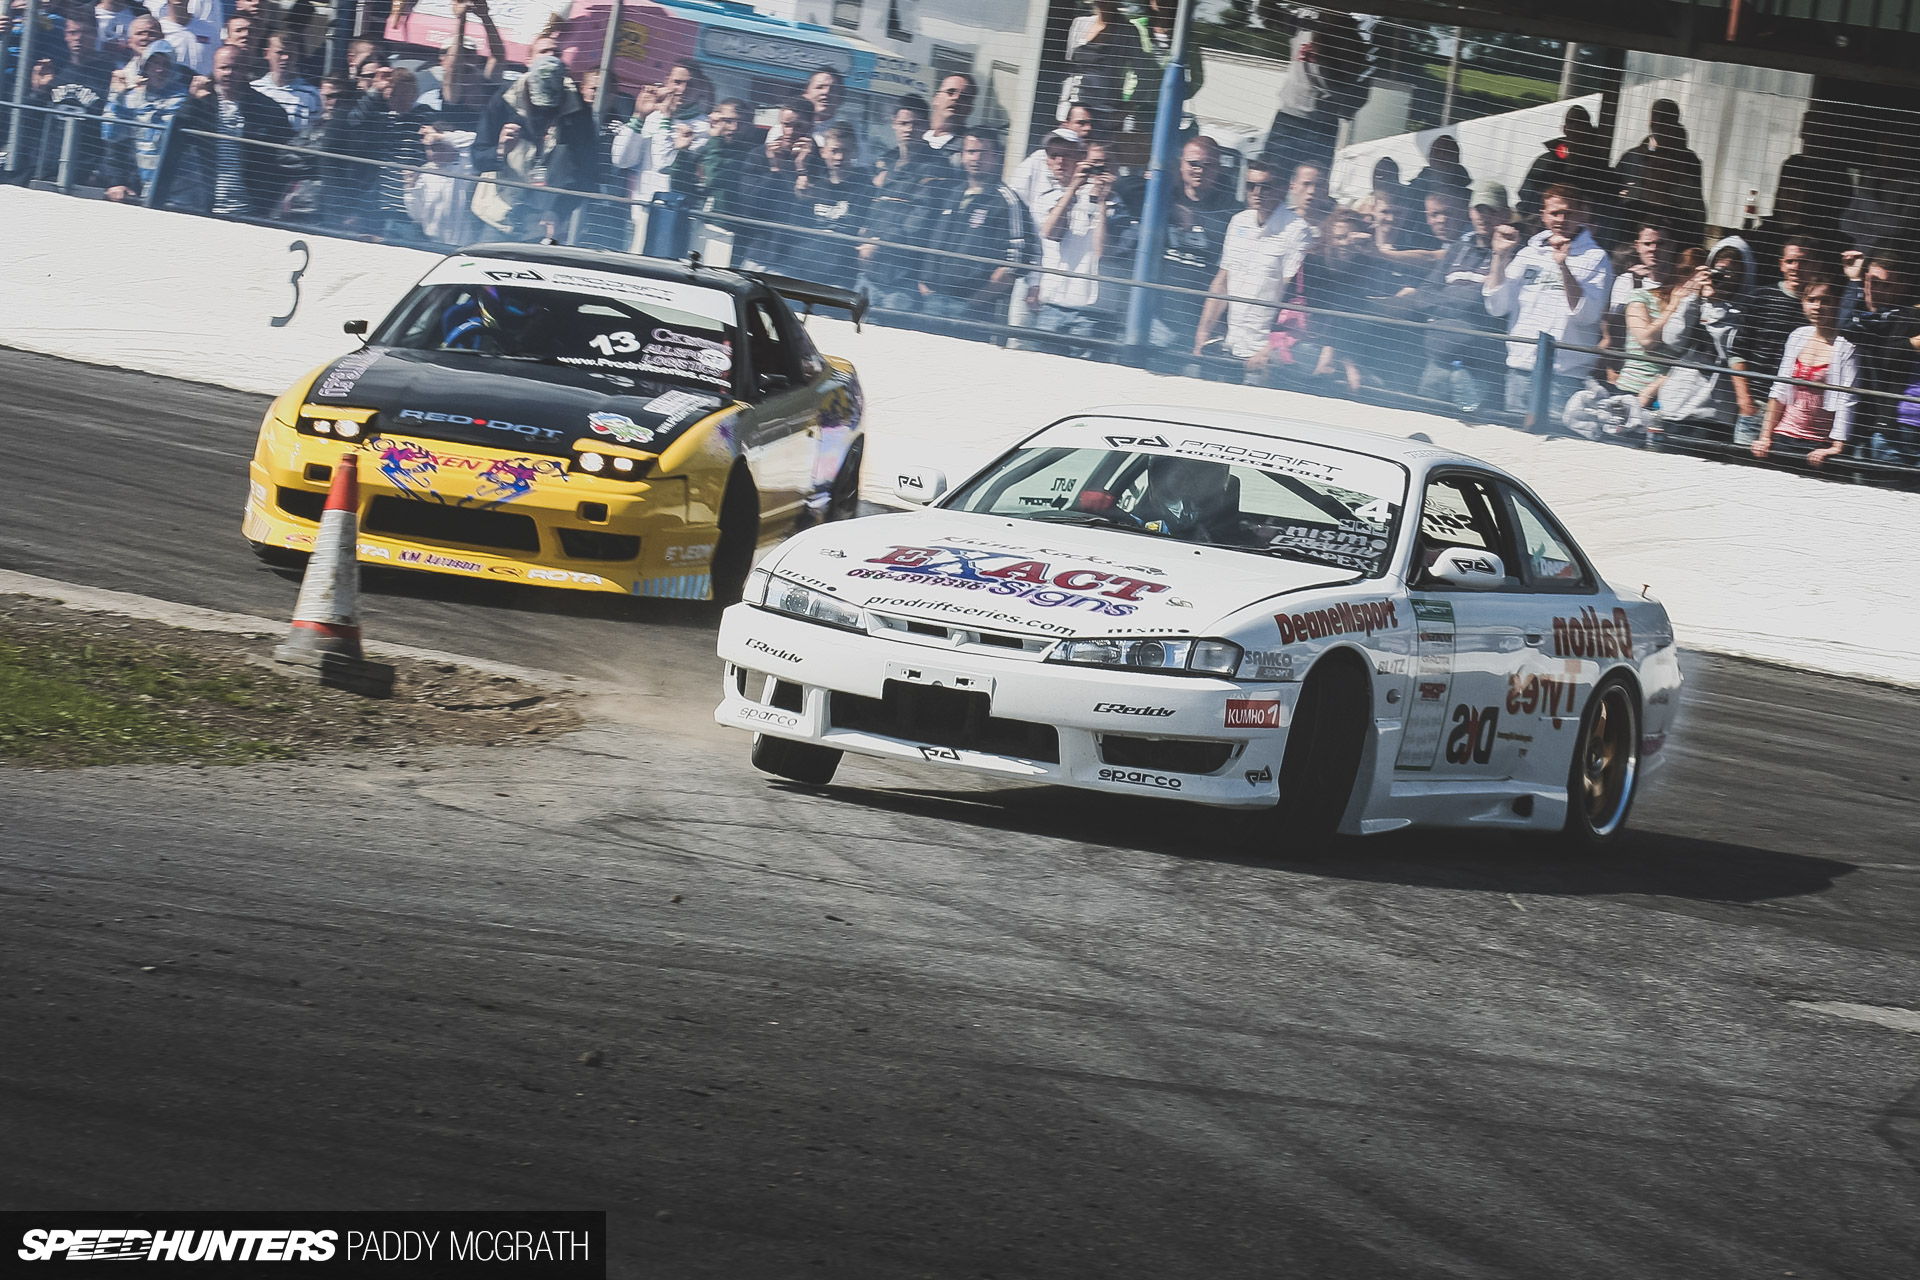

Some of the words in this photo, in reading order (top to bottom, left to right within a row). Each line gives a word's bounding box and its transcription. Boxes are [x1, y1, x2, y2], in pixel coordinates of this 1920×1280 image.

[271, 240, 309, 327] 3
[589, 331, 641, 356] 13
[400, 409, 472, 425] RED
[485, 419, 564, 437] DOT
[1180, 440, 1343, 473] PRODRIFT
[1355, 499, 1392, 523] 4
[1285, 526, 1388, 550] nismo
[527, 568, 604, 585] ROTA
[863, 546, 1171, 602] EXACT
[864, 595, 1077, 638] prodriftseries.com
[745, 637, 803, 664] GReddy
[1245, 650, 1292, 668] SAMCO
[1263, 668, 1290, 678] sport
[738, 707, 798, 728] sparco
[1093, 702, 1176, 717] GReddy
[1228, 708, 1265, 724] KUMHO
[1098, 768, 1182, 789] sparco
